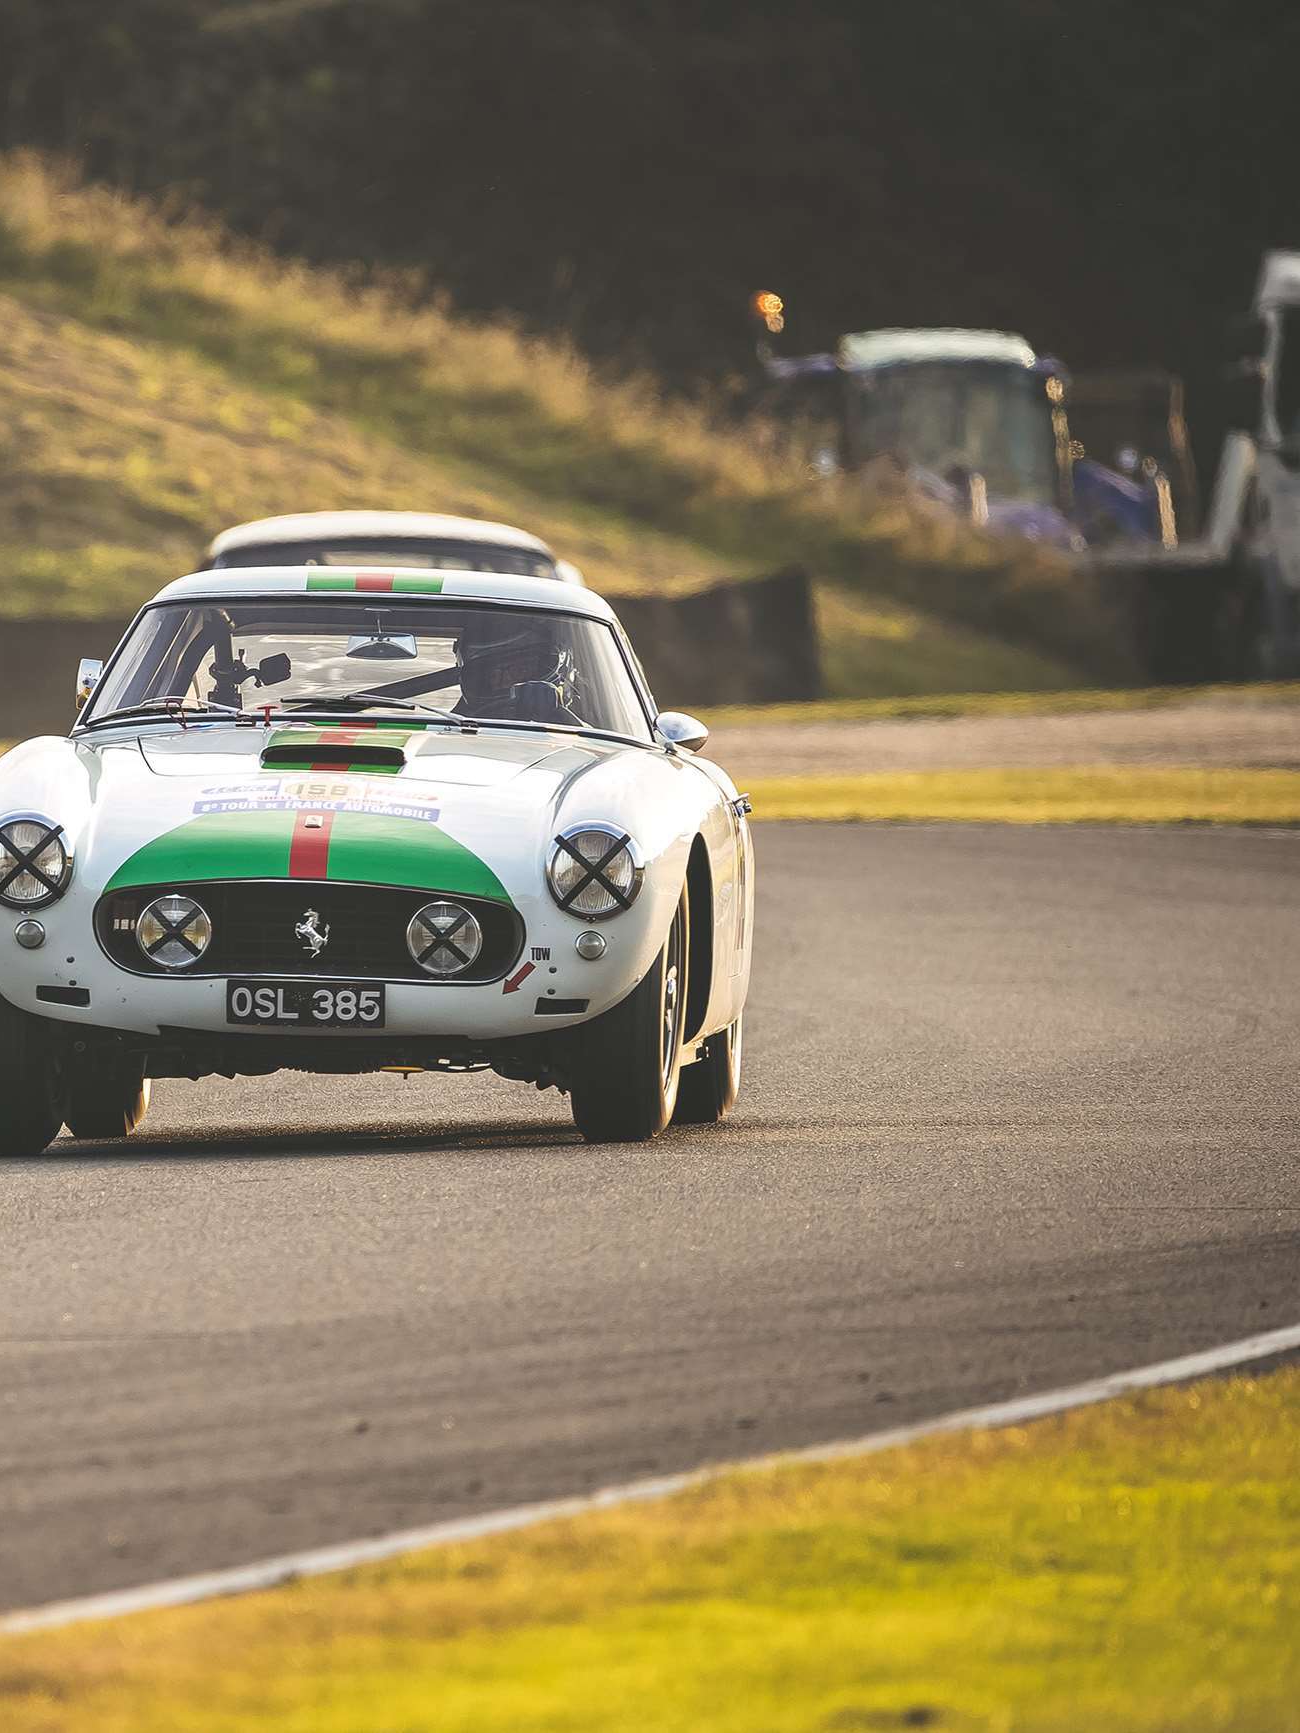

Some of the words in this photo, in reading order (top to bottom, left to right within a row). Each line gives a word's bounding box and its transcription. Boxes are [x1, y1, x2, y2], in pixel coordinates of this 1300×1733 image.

[219, 801, 258, 811] TOUR
[284, 799, 339, 810] FRANCE
[343, 801, 432, 820] AUTOMOBILE
[530, 947, 551, 961] TOW
[231, 987, 299, 1020] OSL
[312, 989, 381, 1022] 385
